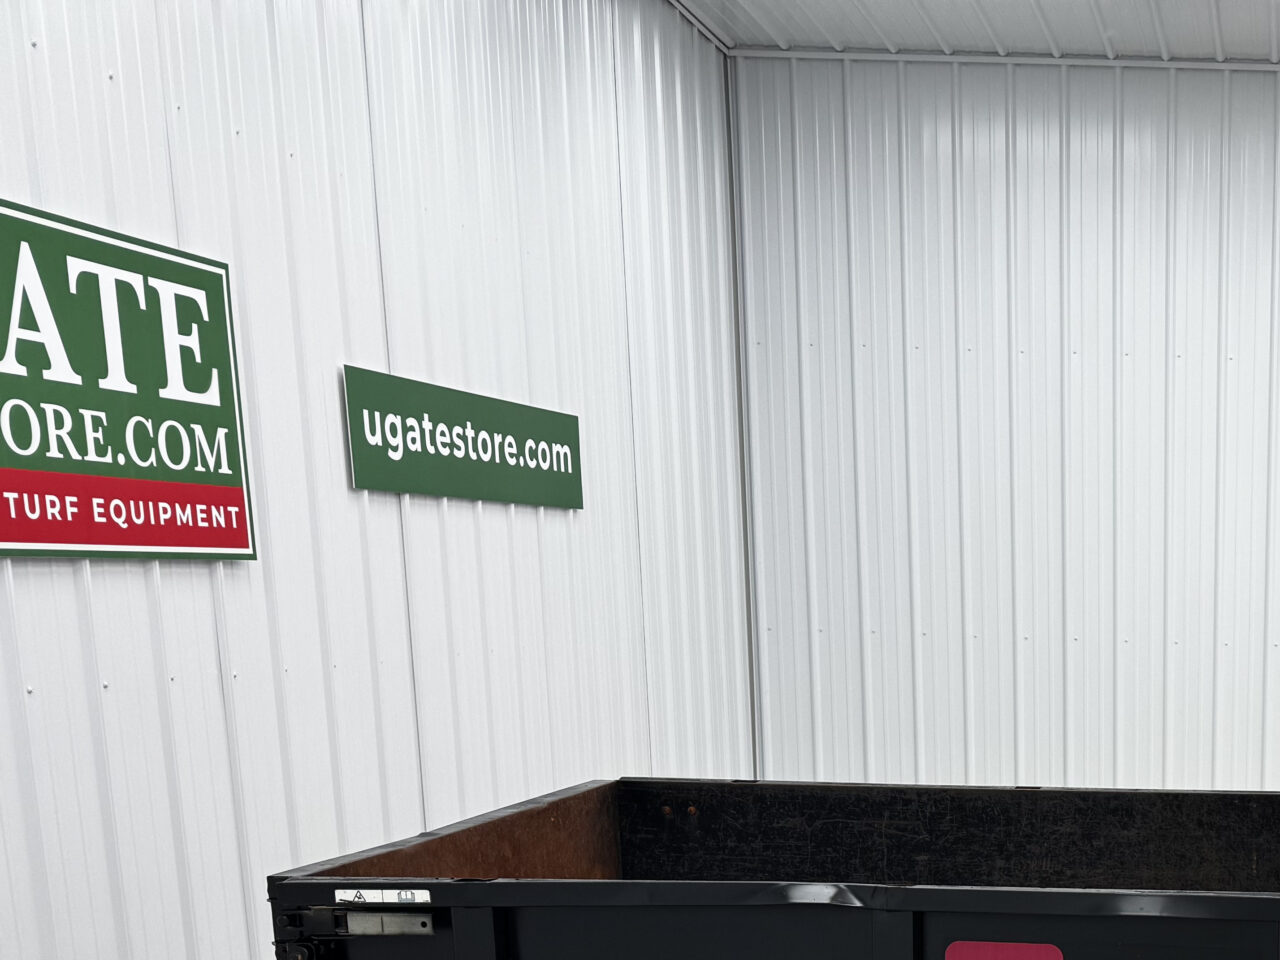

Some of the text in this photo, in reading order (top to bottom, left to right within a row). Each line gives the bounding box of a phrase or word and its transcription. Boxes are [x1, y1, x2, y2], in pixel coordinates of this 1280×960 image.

[0, 398, 233, 475] ORE.COM
[363, 409, 573, 473] ugatestore.com
[3, 491, 239, 528] TURF EQUIPMENT
